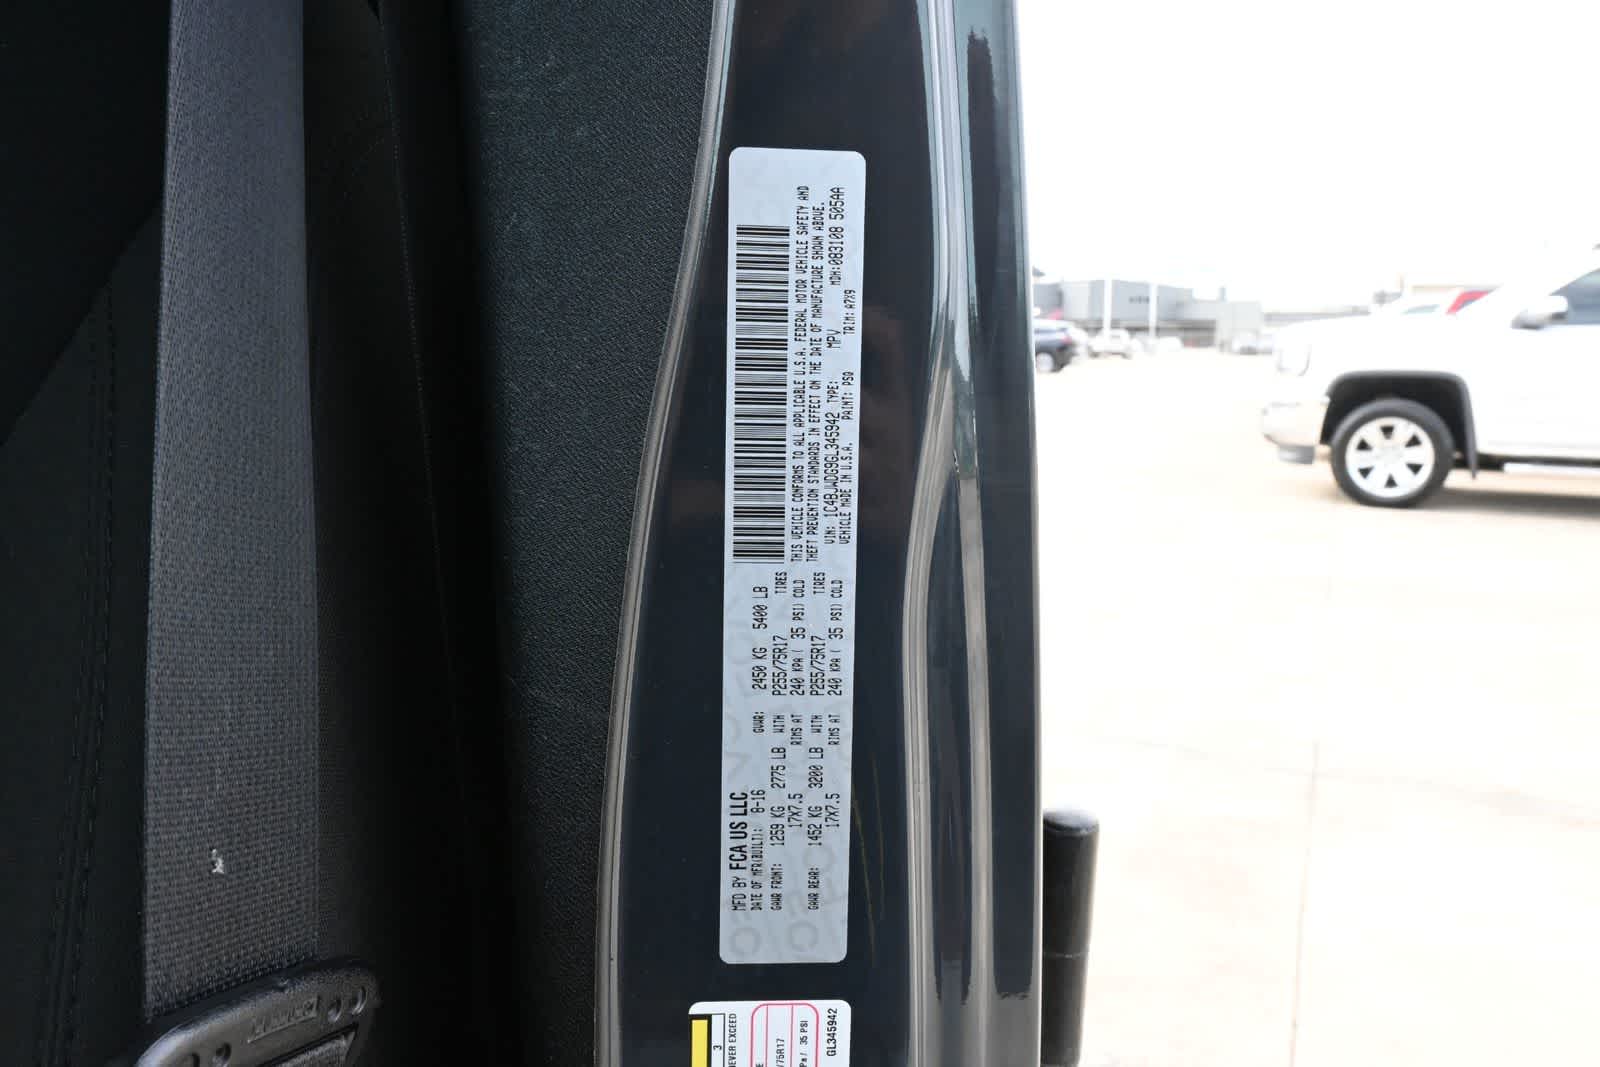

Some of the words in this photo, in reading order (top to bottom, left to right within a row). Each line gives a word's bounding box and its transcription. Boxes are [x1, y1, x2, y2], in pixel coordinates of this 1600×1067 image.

[797, 186, 809, 200] AND
[829, 187, 845, 220] 505AA
[797, 206, 808, 235] SAFETY
[812, 202, 825, 231] ABOVE.
[796, 240, 808, 274] VEHICLE
[812, 236, 824, 260] SHOWN
[796, 279, 807, 303] MOTOR
[811, 265, 823, 318] MANUFACTURE
[795, 308, 807, 342] FEDERAL
[811, 324, 822, 333] OF
[844, 312, 855, 335] TRIM:
[810, 337, 822, 356] DATE
[827, 329, 841, 349] MPV
[794, 348, 807, 376] U.S.A.
[810, 362, 821, 375] THE
[809, 380, 821, 390] ON
[827, 381, 839, 403] TYPE:
[793, 380, 805, 427] APPLICABLE
[809, 395, 821, 423] EFFECT
[842, 392, 854, 420] PAINT:
[793, 433, 805, 446] ALL
[808, 428, 820, 436] IN
[793, 451, 804, 459] TO
[808, 442, 820, 484] STANDARDS
[824, 412, 840, 518] 1C4BJWDG9GL345942
[841, 442, 852, 470] U.S.A.
[792, 465, 804, 502] CONFORMS
[841, 475, 852, 483] IN
[840, 489, 852, 507] MADE
[807, 489, 819, 535] PREVENTION
[791, 507, 804, 539] VEHICLE
[839, 512, 851, 544] VEHICLE
[824, 526, 835, 544] VIN:
[791, 544, 803, 562] THIS
[806, 540, 818, 562] THEFT
[753, 586, 767, 598] LB
[775, 571, 787, 594] TIRES
[793, 580, 805, 598] COLD
[813, 572, 825, 595] TIRES
[831, 580, 843, 598] COLD
[753, 605, 767, 629] 5400
[791, 627, 805, 639] 35
[829, 627, 843, 640] 35
[753, 647, 767, 660] KG
[773, 636, 787, 696] P255/75R17
[792, 658, 803, 672] KPA
[811, 636, 825, 696] P255/75R17
[830, 658, 841, 672] KPA
[752, 666, 766, 690] 2450
[790, 678, 805, 696] 240
[828, 678, 842, 696] 240
[774, 715, 784, 733] WITH
[791, 714, 802, 723] AT
[811, 715, 822, 733] WITH
[829, 714, 840, 723] AT
[791, 728, 802, 745] RIMS
[829, 728, 840, 745] RIMS
[772, 747, 786, 759] LB
[809, 747, 823, 759] LB
[772, 765, 785, 788] 2775
[809, 765, 823, 788] 3200
[730, 792, 747, 816] LLC
[751, 790, 765, 813] 8-16
[788, 793, 802, 828] 17X7.5
[825, 793, 840, 827] 17X7.5
[772, 806, 785, 818] KG
[808, 806, 822, 818] KG
[730, 822, 747, 839] US
[771, 824, 784, 846] 1259
[808, 824, 822, 846] 1452
[729, 845, 747, 870] FCA
[733, 876, 746, 887] BY
[751, 880, 762, 889] OF
[772, 863, 782, 889] FRONT:
[808, 867, 820, 889] REAR:
[732, 894, 746, 911] MFD
[751, 894, 762, 911] DATE
[771, 893, 782, 911] GAWR
[808, 893, 819, 910] GAWR
[728, 1013, 737, 1043] EXCEED
[800, 1020, 808, 1032] PSI
[826, 1007, 838, 1057] GL345942
[800, 1034, 808, 1044] 35
